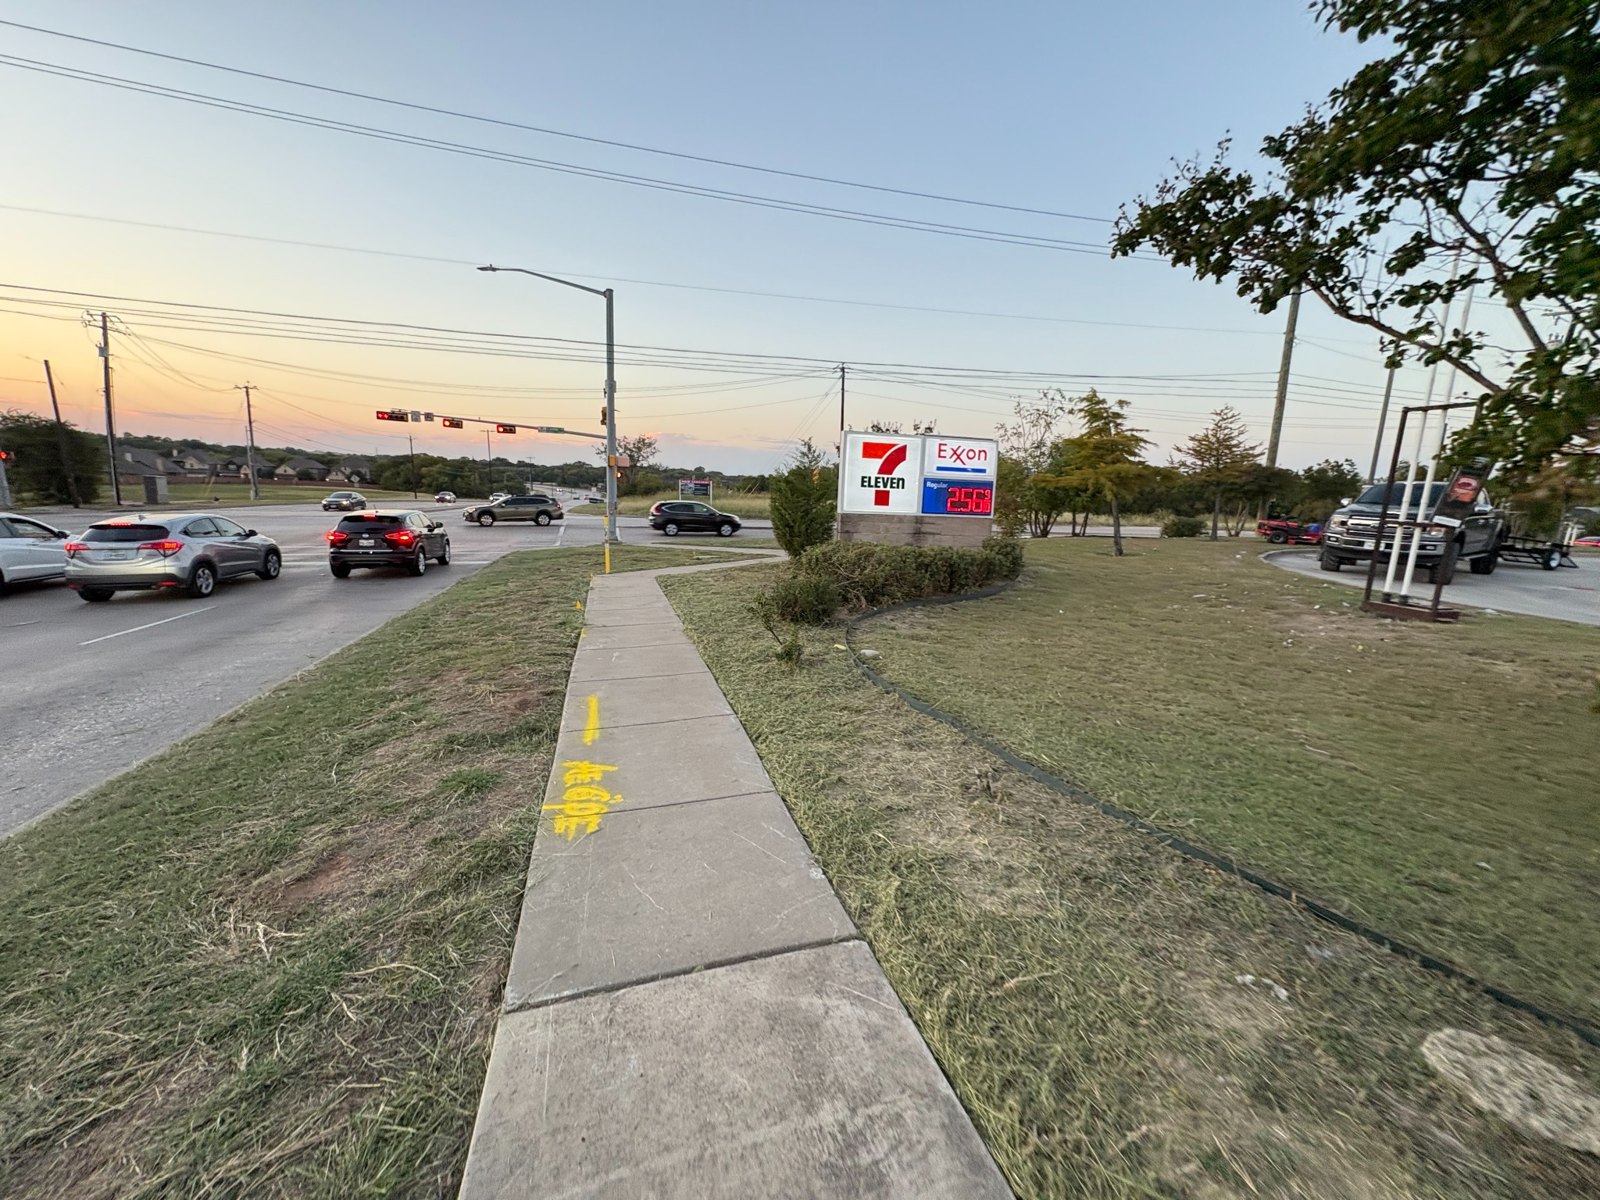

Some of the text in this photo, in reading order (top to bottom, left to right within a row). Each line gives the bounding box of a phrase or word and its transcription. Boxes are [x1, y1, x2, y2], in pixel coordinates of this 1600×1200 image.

[937, 443, 988, 465] Exxon
[862, 442, 907, 506] 7
[926, 481, 948, 489] Regular
